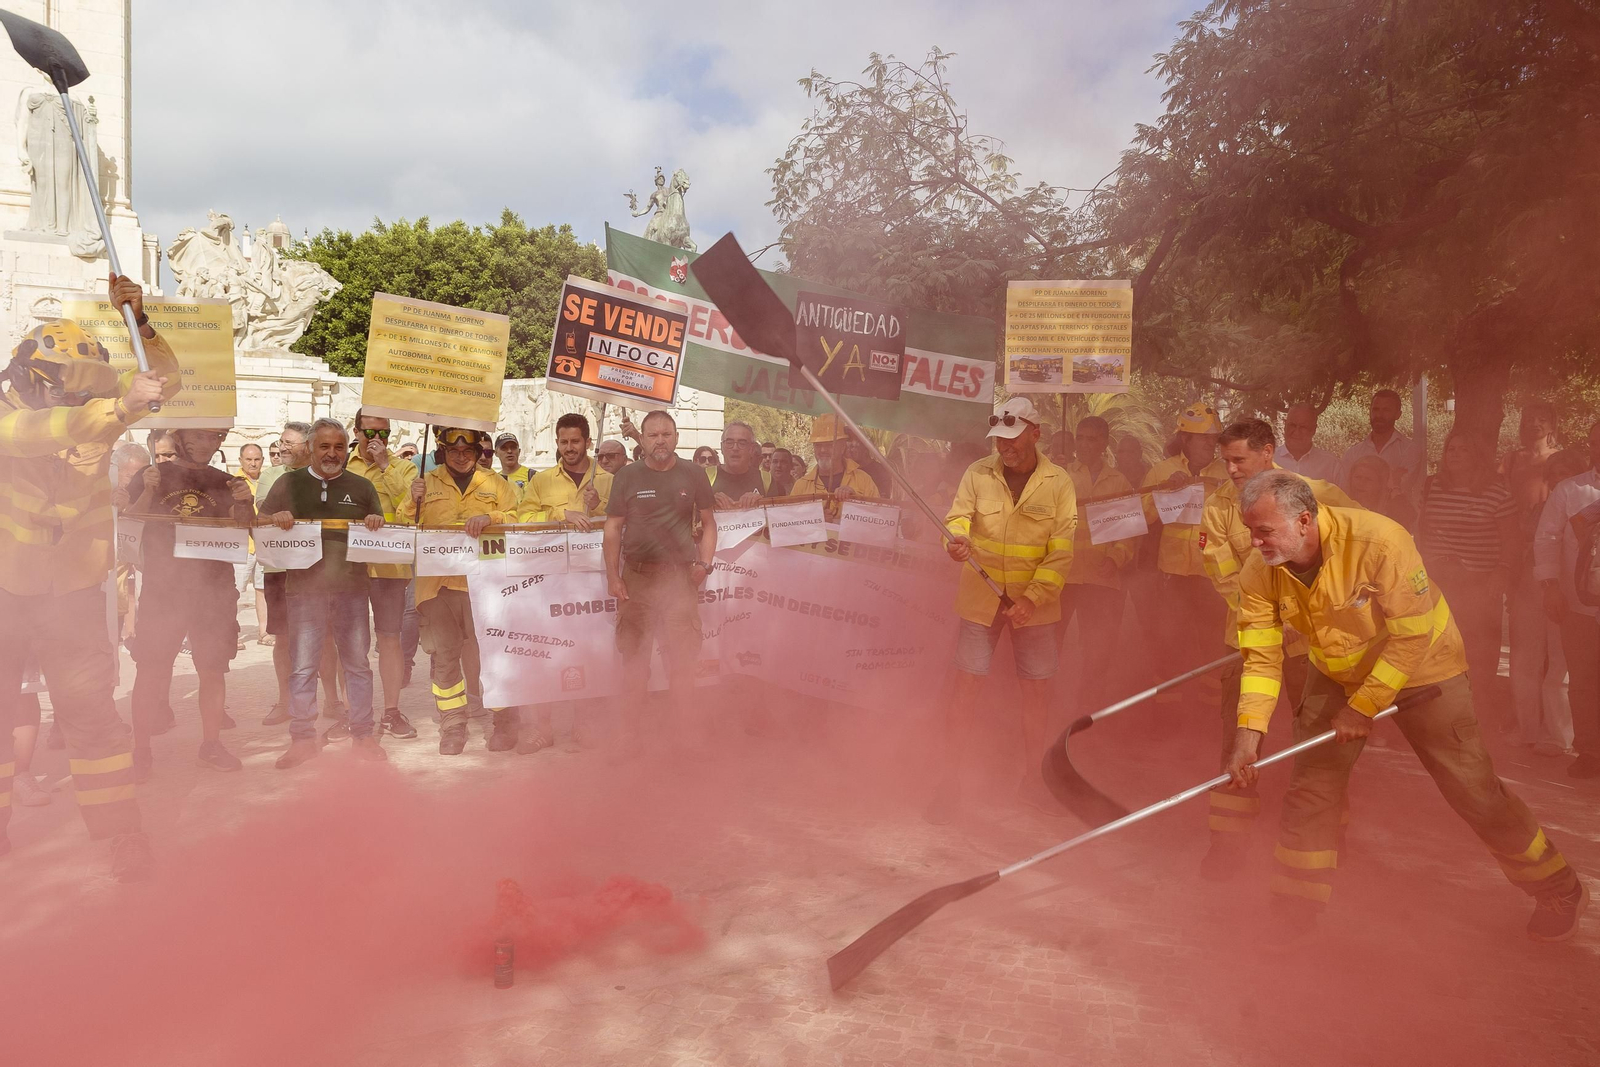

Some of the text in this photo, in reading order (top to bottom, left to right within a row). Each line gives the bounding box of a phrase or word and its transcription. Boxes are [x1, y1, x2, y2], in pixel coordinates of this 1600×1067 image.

[163, 305, 200, 313] MORENO
[413, 307, 422, 315] DE
[423, 309, 451, 320] JUANMA
[454, 315, 485, 326] MORENO
[78, 319, 105, 327] JUEGA
[150, 321, 173, 329] STROS
[177, 321, 221, 329] DERECHOS:
[385, 316, 429, 331] DESPILFARRA
[439, 327, 464, 337] DINERO
[465, 330, 474, 338] DE
[563, 293, 598, 326] SE
[604, 302, 685, 348] VENDE
[796, 300, 900, 339] ANTIGÜEDAD
[93, 334, 129, 343] ANTIGÜE
[408, 336, 442, 348] MILLONES
[469, 346, 503, 358] CAMIONES
[388, 348, 491, 370] AUTOBOMBA CON PROBLEMAS
[817, 336, 867, 382] YA
[470, 375, 484, 383] QUE
[611, 367, 645, 379] PREGUNTAR
[900, 354, 985, 399] TALES
[373, 375, 496, 400] COMPROMETEN NUESTRA SEGURIDAD
[599, 374, 653, 391] JUANMA MORENO
[717, 520, 764, 533] ABORALES
[771, 517, 823, 529] FUNDAMENTALES
[185, 539, 240, 550] ESTAMOS
[262, 538, 316, 550] VENDIDOS
[351, 537, 412, 550] ANDALUCÍA
[422, 545, 475, 555] SE QUEMA
[509, 544, 565, 556] BOMBEROS
[571, 541, 604, 552] FOREST
[824, 538, 851, 557] SE
[713, 561, 758, 579] NTIGÜEDAD
[500, 573, 545, 598] SIN EPIS
[863, 579, 882, 592] SIN
[549, 598, 619, 618] BOMBE
[756, 590, 882, 630] SIN DERECHOS
[485, 627, 576, 648] SIN ESTABILIDAD
[504, 645, 553, 660] LABORAL
[845, 648, 863, 658] SIN
[866, 646, 916, 656] TRASLADO
